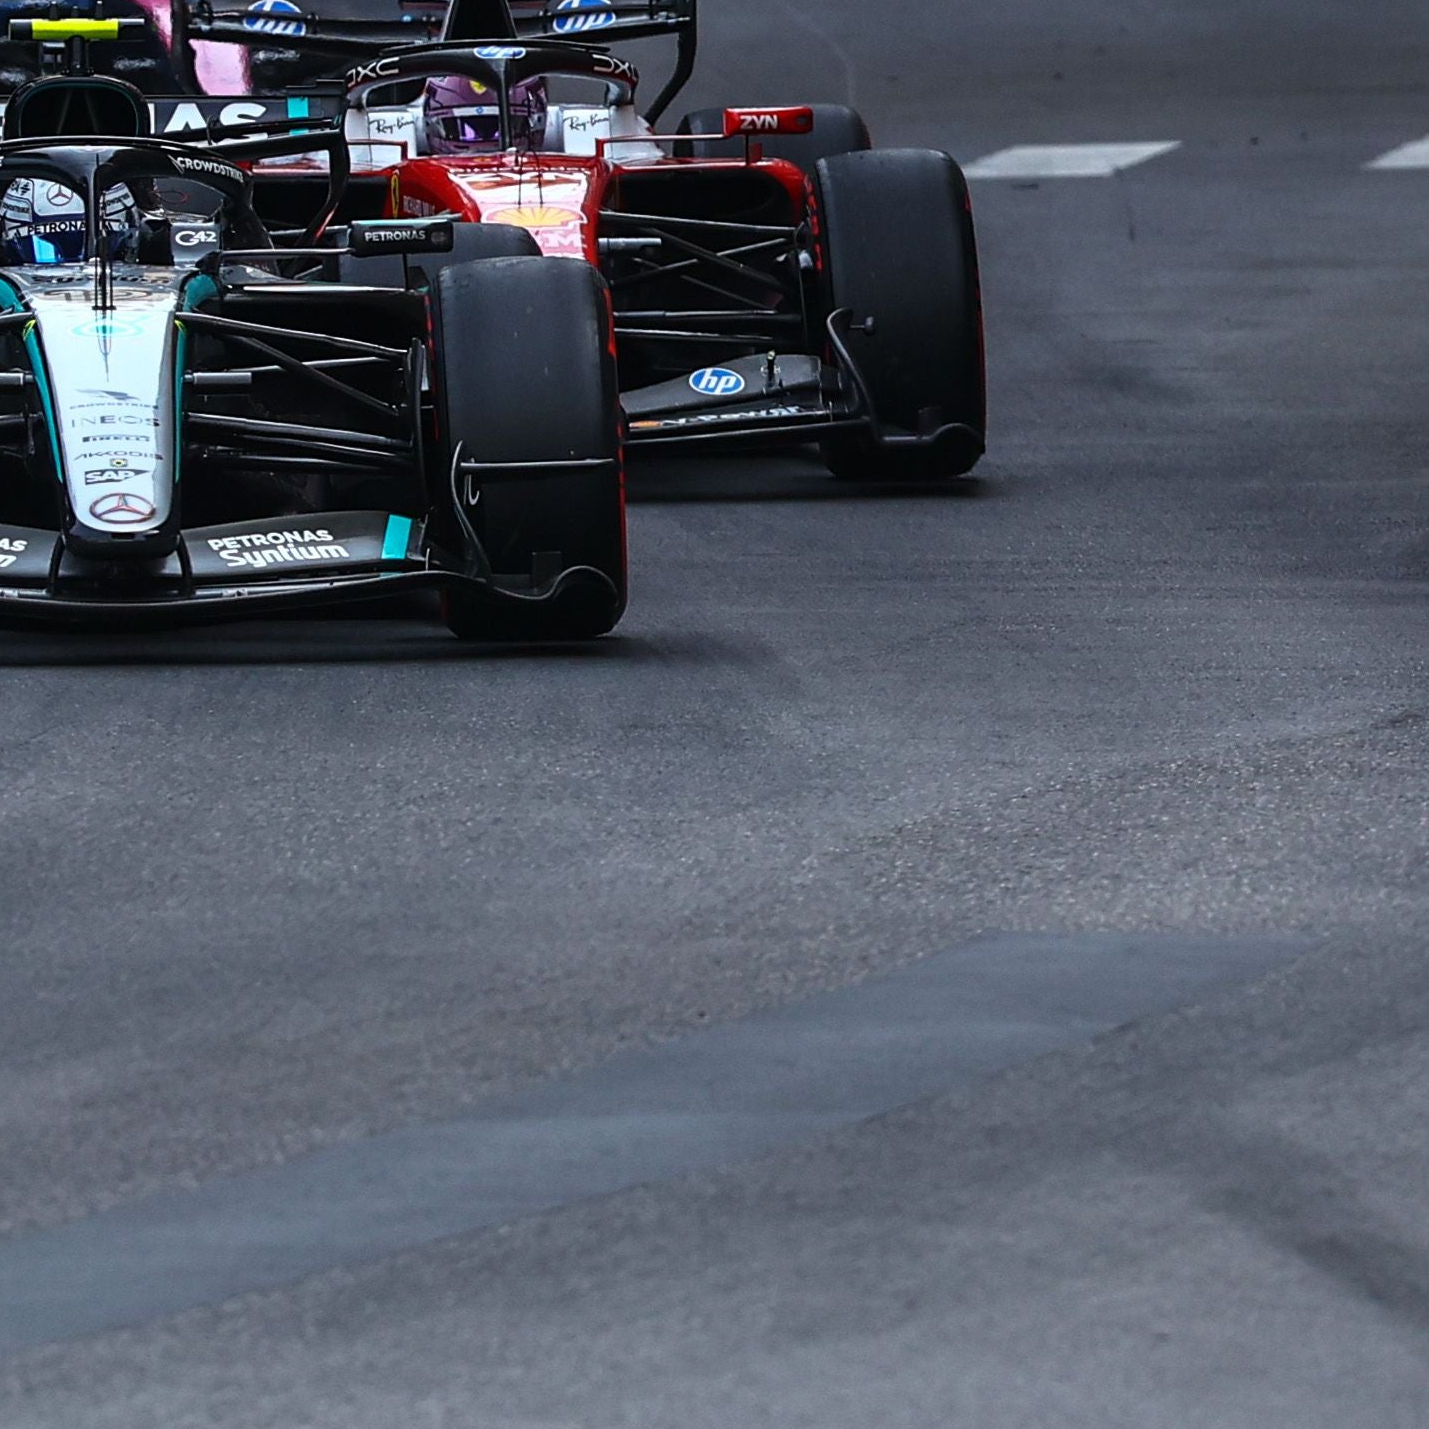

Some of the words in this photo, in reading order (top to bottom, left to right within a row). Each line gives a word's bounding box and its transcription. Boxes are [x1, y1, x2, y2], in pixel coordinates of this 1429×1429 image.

[739, 114, 779, 130] ZYN
[363, 229, 427, 244] PETRONAS
[698, 368, 740, 395] hp
[71, 415, 161, 428] INEOS
[85, 470, 137, 484] SAP
[206, 529, 335, 552] PETRONAS
[218, 542, 350, 569] Syntium
